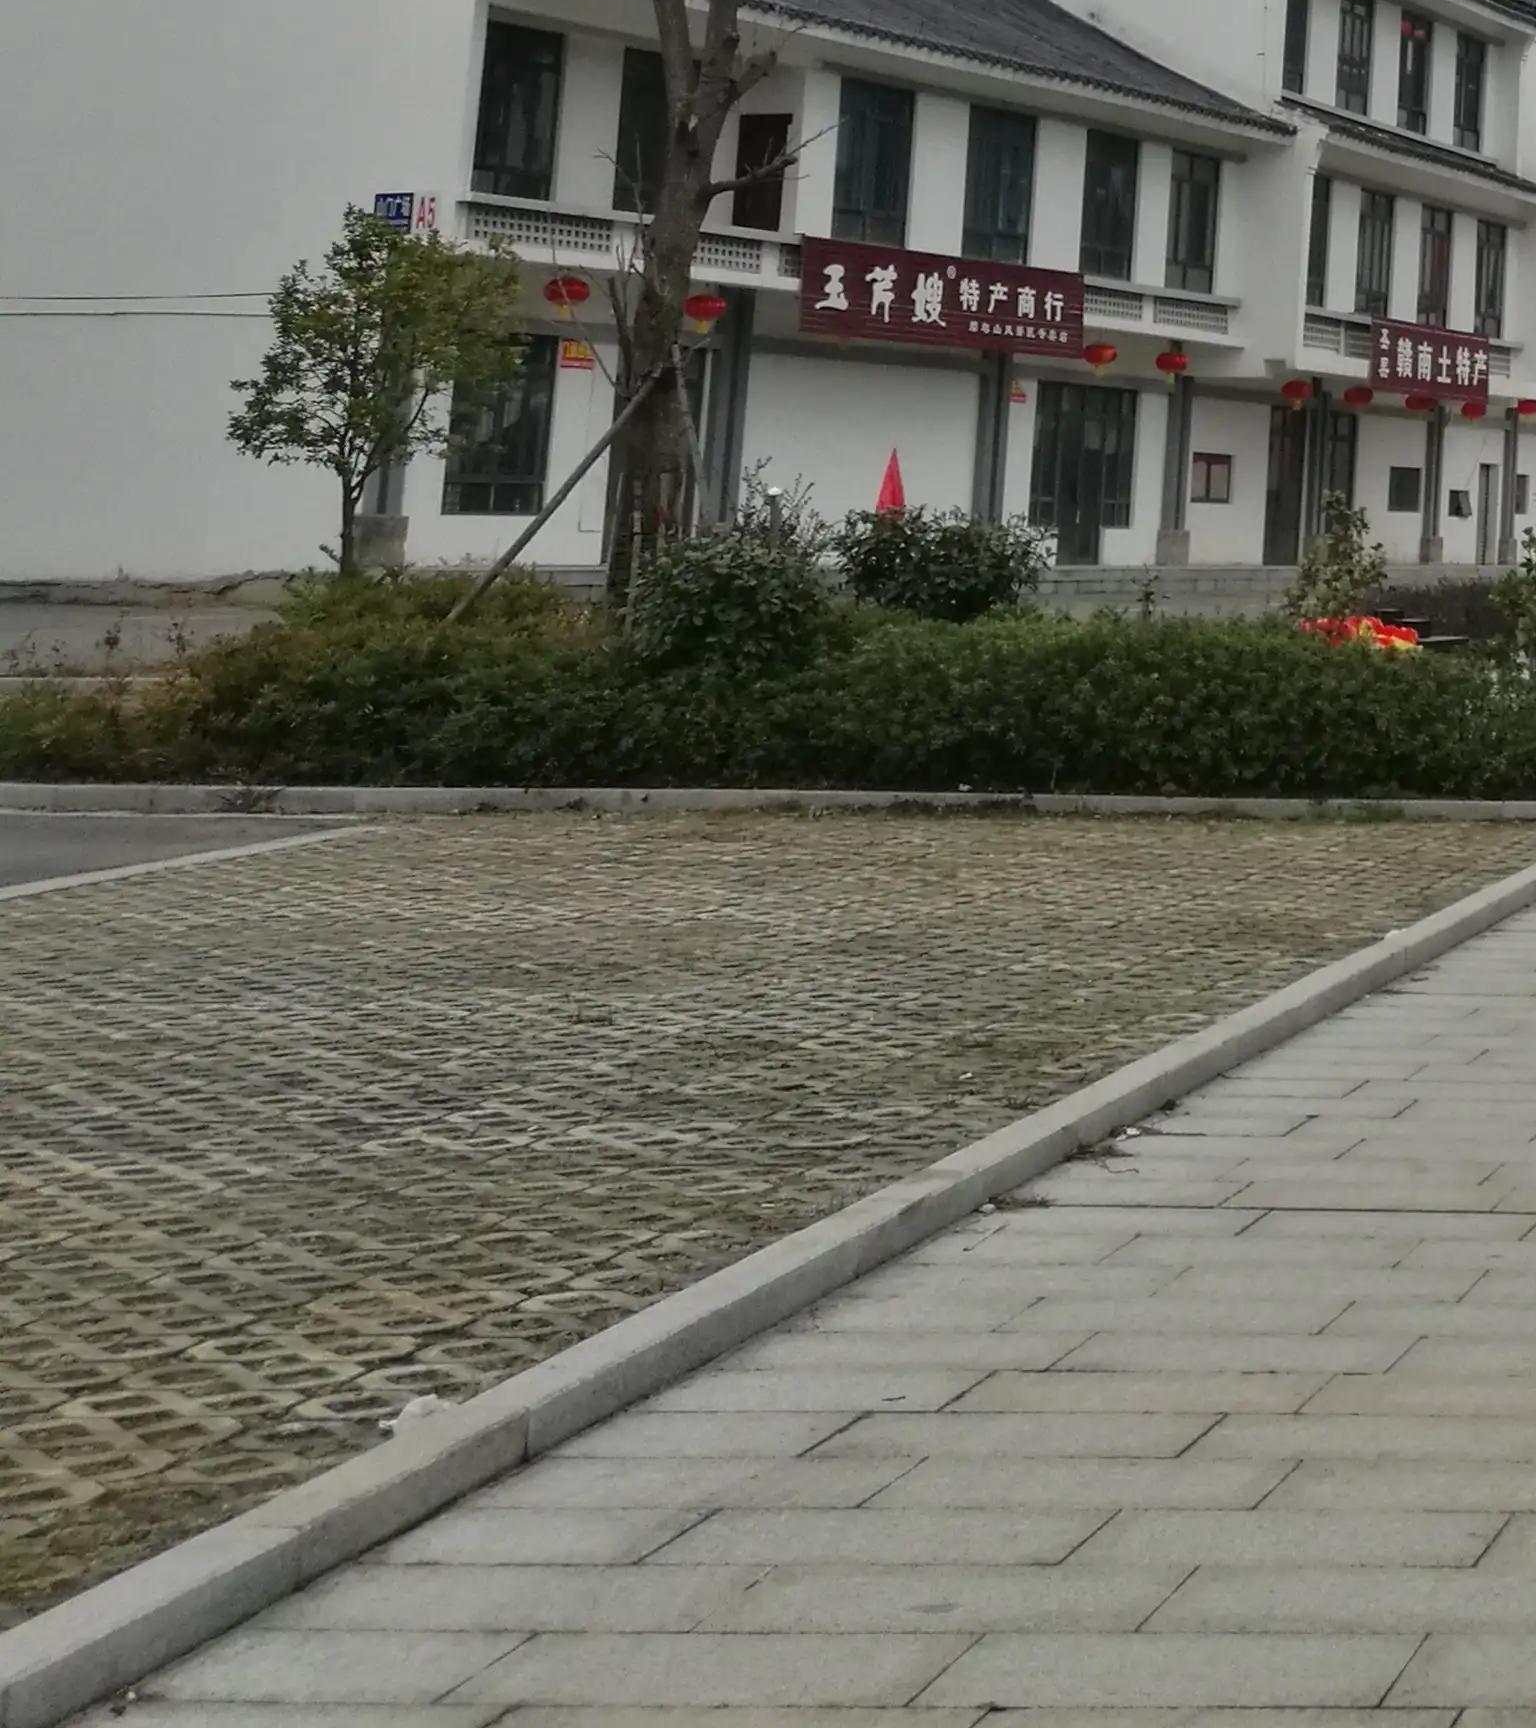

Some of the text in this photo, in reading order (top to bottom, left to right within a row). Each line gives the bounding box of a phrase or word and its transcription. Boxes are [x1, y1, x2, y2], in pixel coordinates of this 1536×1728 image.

[416, 197, 436, 229] A5
[959, 278, 1065, 322] 特产商行
